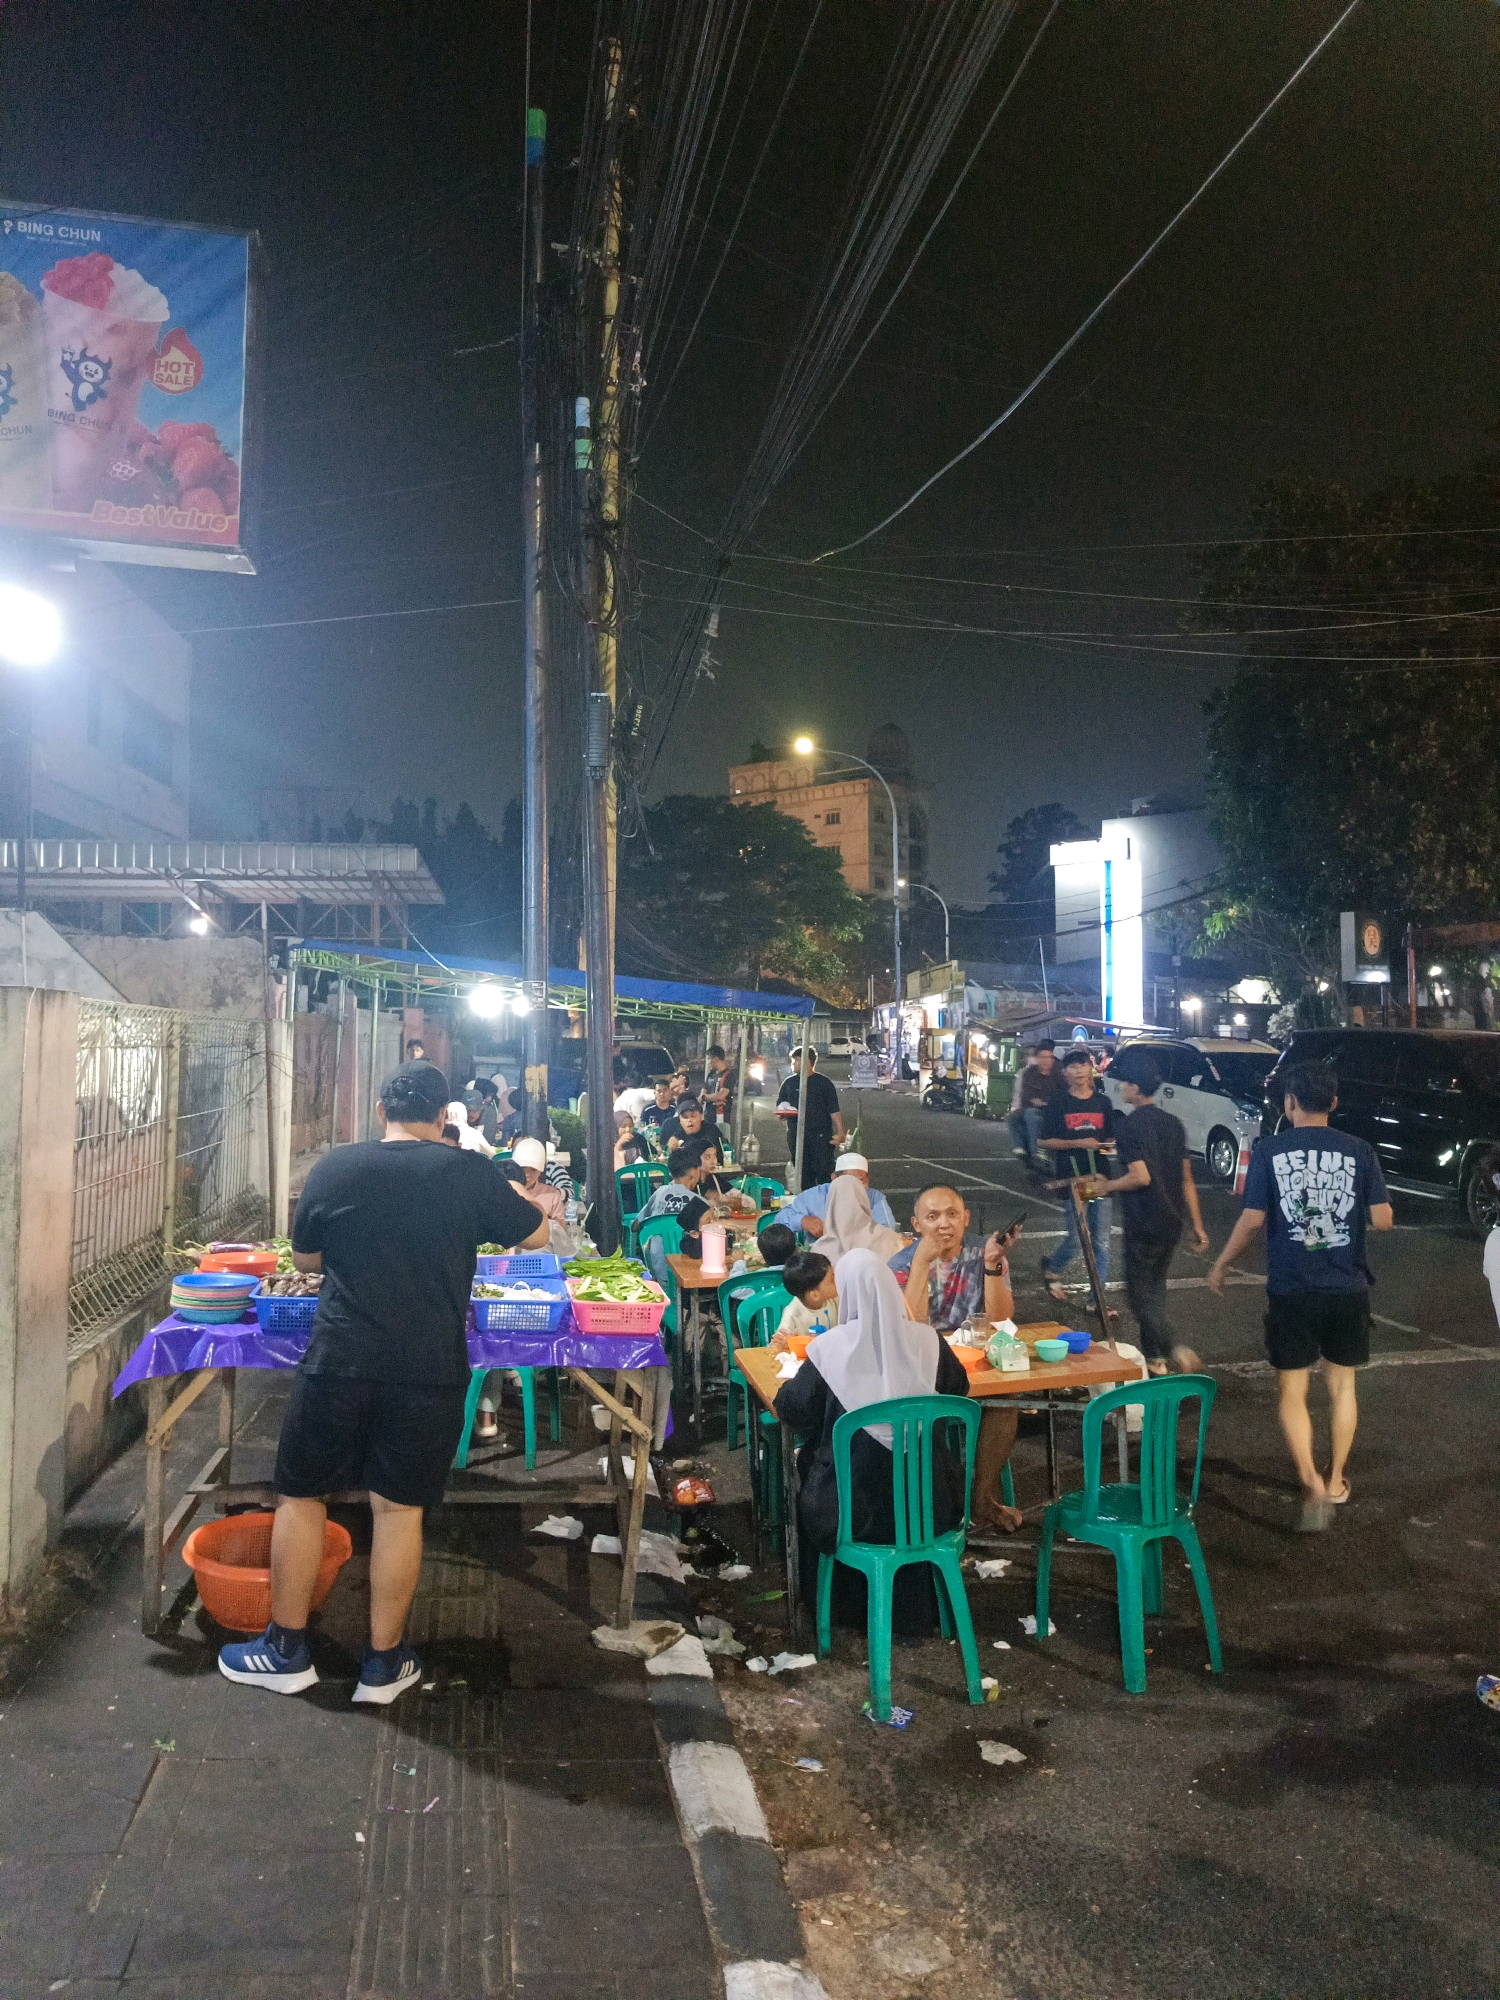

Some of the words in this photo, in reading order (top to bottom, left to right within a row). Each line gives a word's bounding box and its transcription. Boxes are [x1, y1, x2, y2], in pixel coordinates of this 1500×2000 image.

[17, 221, 54, 236] BING
[58, 226, 101, 242] CHUN
[156, 359, 194, 374] HOT
[154, 372, 194, 386] SALE
[47, 408, 76, 422] BING
[92, 500, 155, 525] Best
[157, 505, 229, 532] Value
[1272, 1149, 1356, 1177] BEING
[1275, 1168, 1356, 1197] NORMAL
